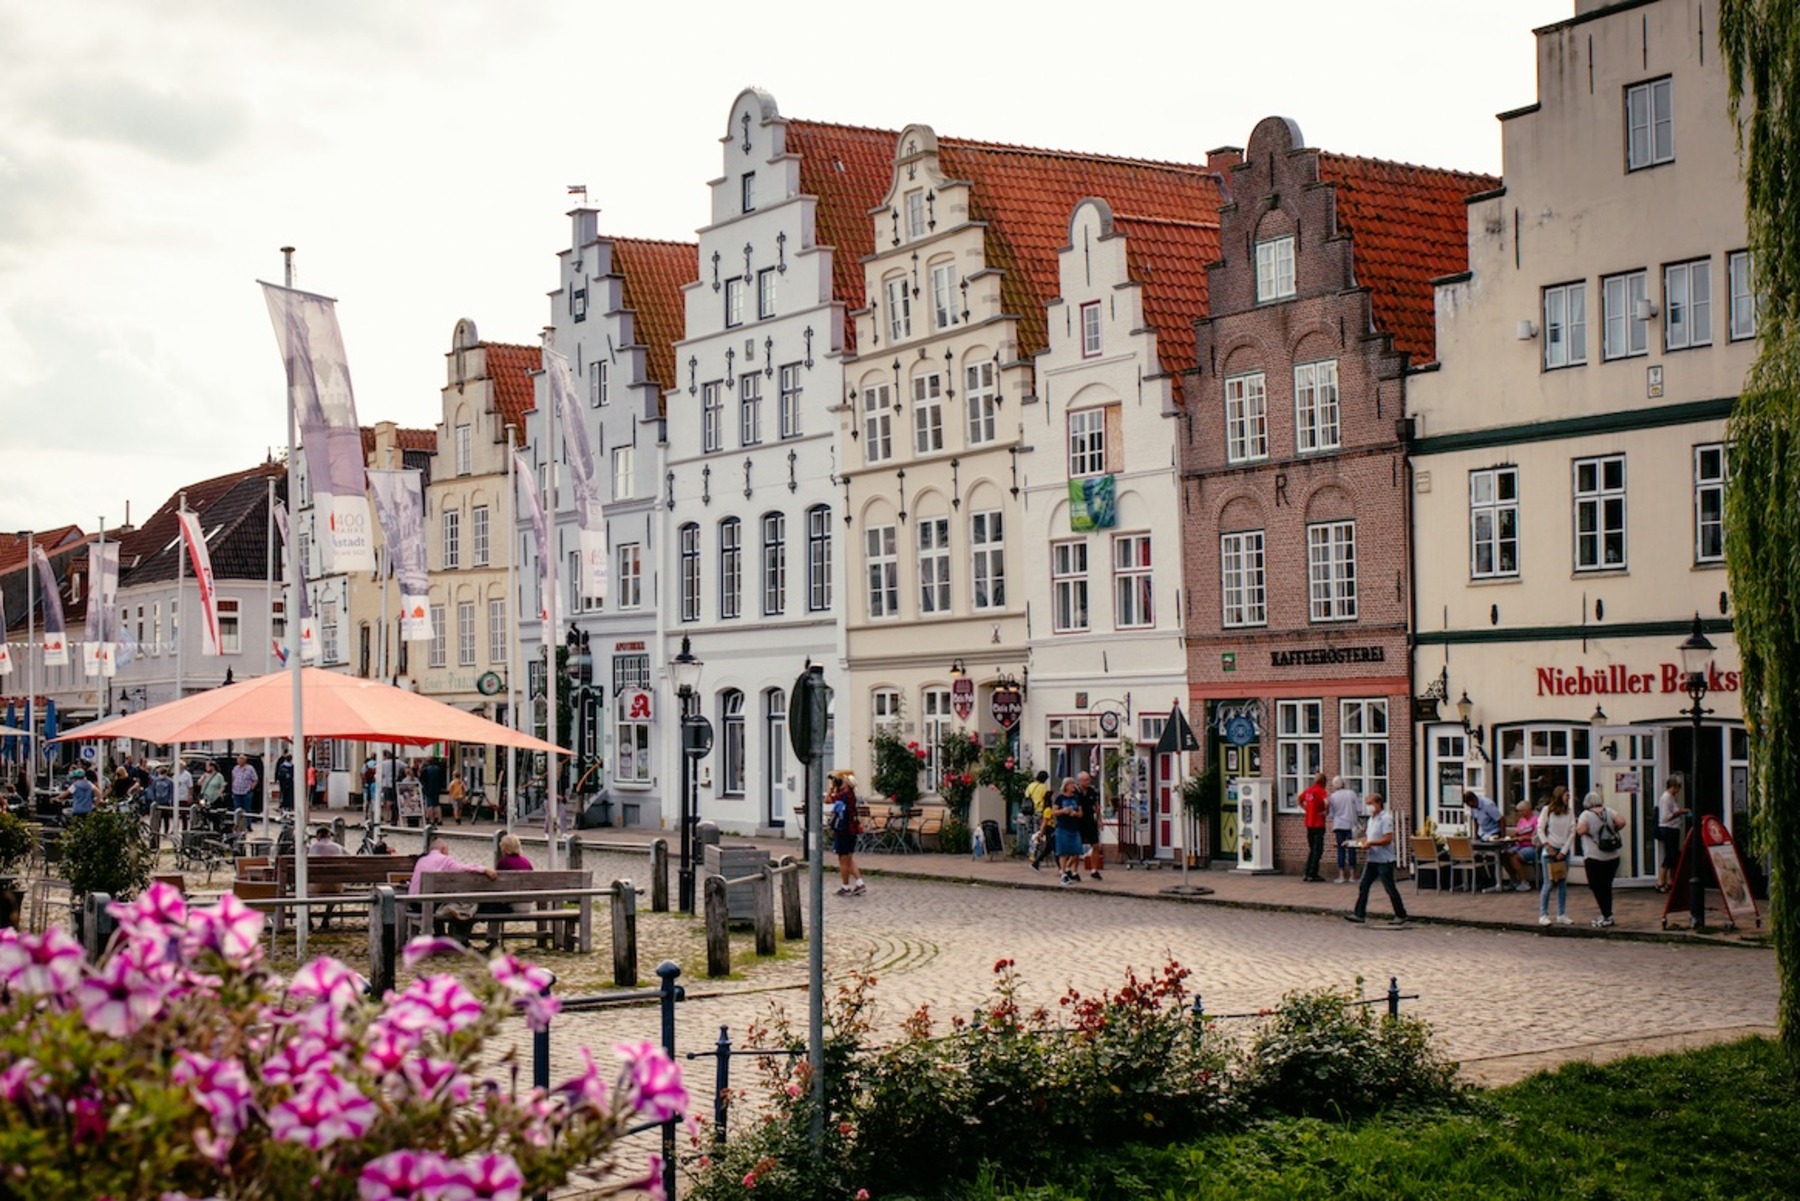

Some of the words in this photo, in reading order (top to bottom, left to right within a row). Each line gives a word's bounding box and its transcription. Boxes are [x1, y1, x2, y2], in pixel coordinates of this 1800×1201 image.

[336, 513, 365, 527] 400
[1536, 664, 1655, 696] Niebüller
[629, 693, 651, 718] A
